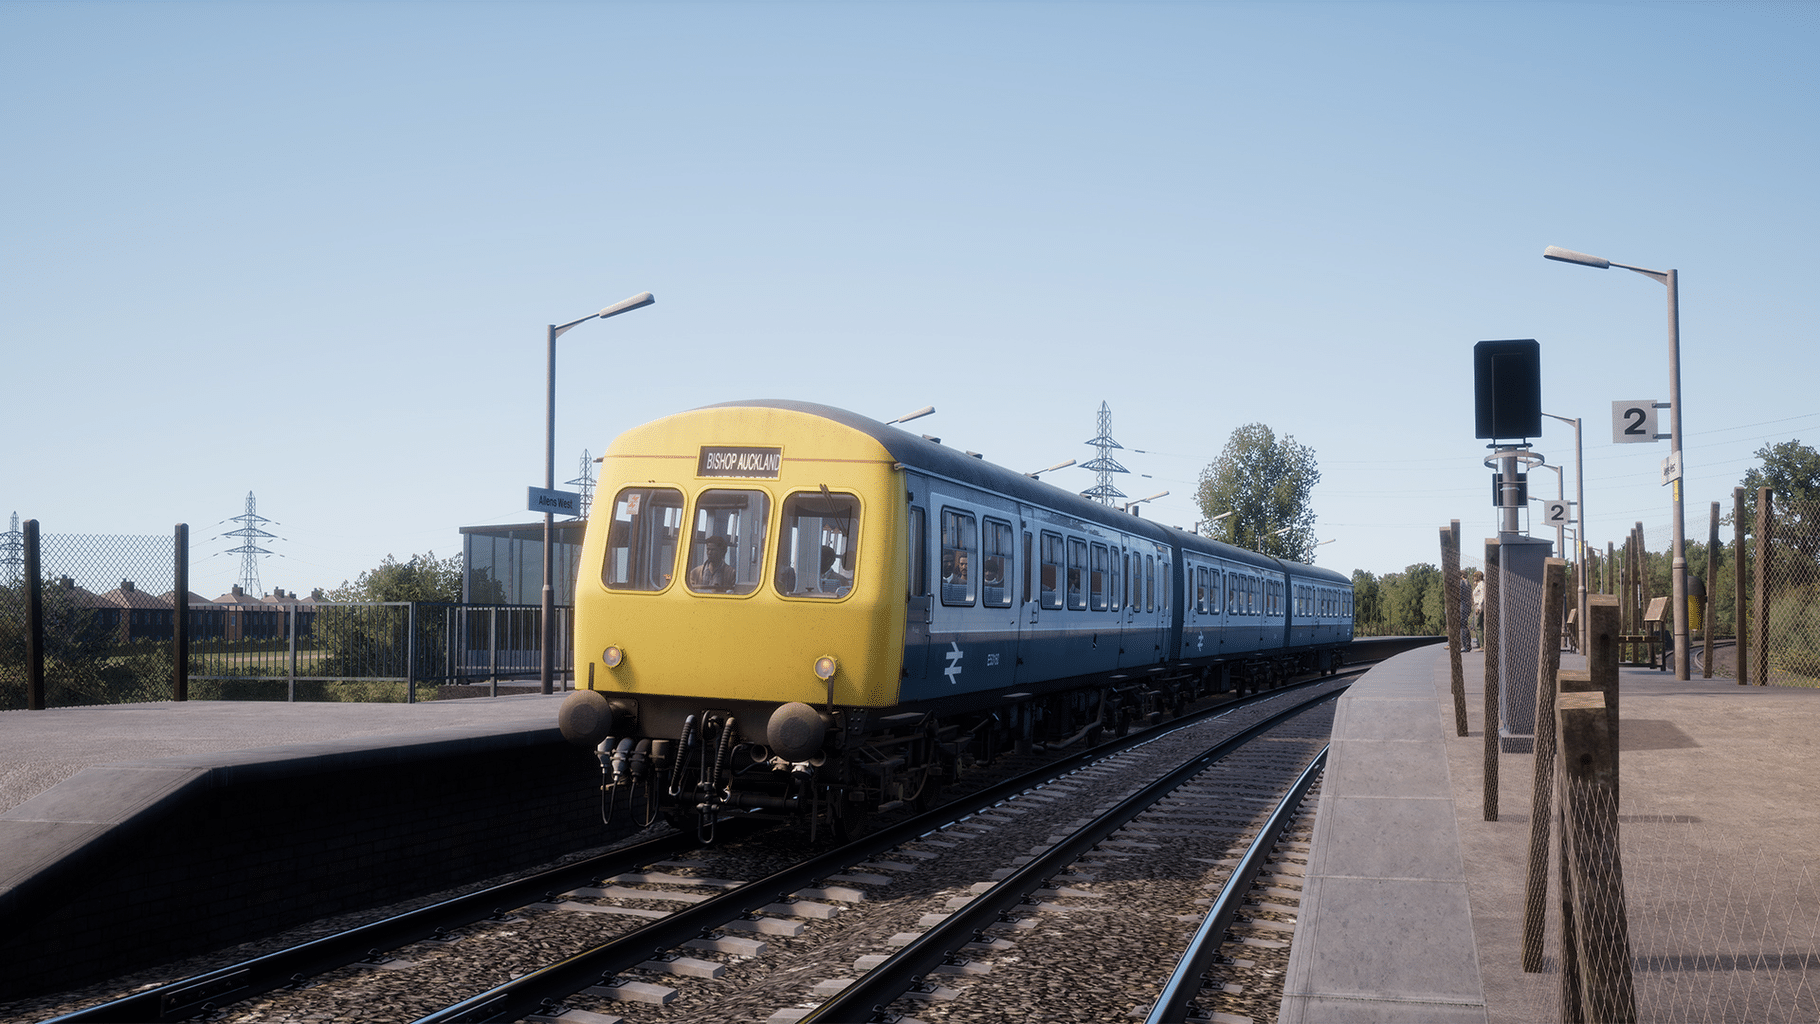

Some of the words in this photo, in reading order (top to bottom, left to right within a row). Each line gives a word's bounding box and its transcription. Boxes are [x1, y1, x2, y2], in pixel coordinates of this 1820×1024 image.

[1624, 408, 1646, 434] 2
[707, 453, 738, 471] BISHOP
[737, 453, 781, 471] AUCKLAND
[539, 495, 557, 507] Allens
[558, 498, 573, 509] West
[1551, 504, 1564, 521] 2
